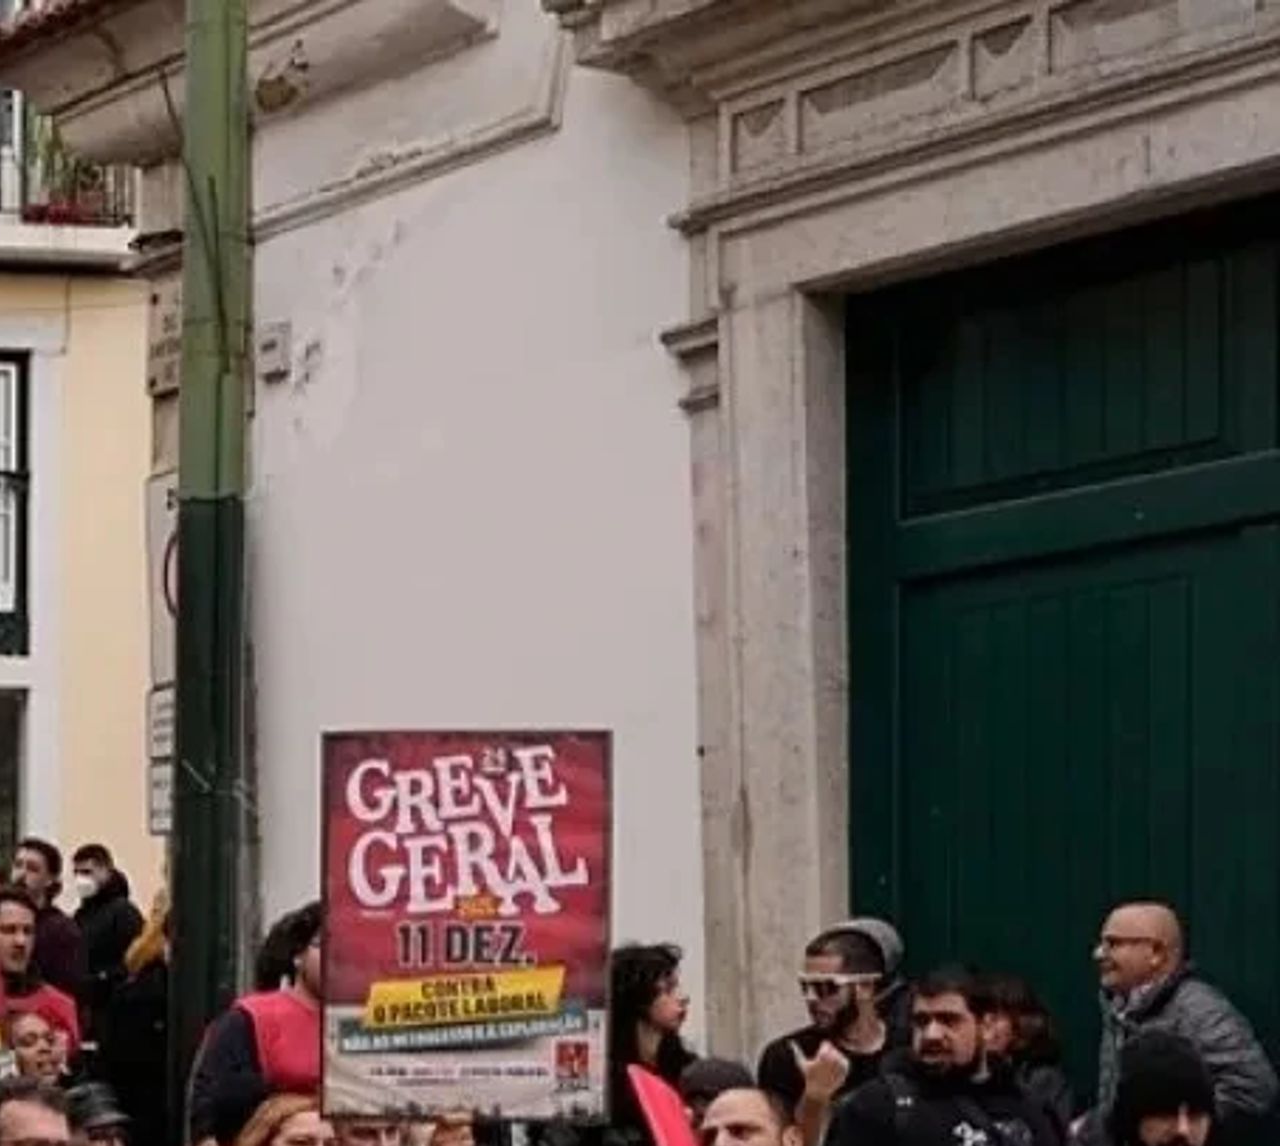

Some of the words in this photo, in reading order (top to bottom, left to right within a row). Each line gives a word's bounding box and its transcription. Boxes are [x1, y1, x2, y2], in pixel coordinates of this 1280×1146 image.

[347, 745, 567, 837] GREVE
[349, 814, 588, 914] GERAL
[397, 923, 431, 967] 11
[446, 924, 535, 965] DEZ.
[372, 1004, 386, 1023] O
[391, 1001, 459, 1022] PACOTE
[462, 991, 549, 1015] LABORAL
[421, 976, 496, 999] CONTRA
